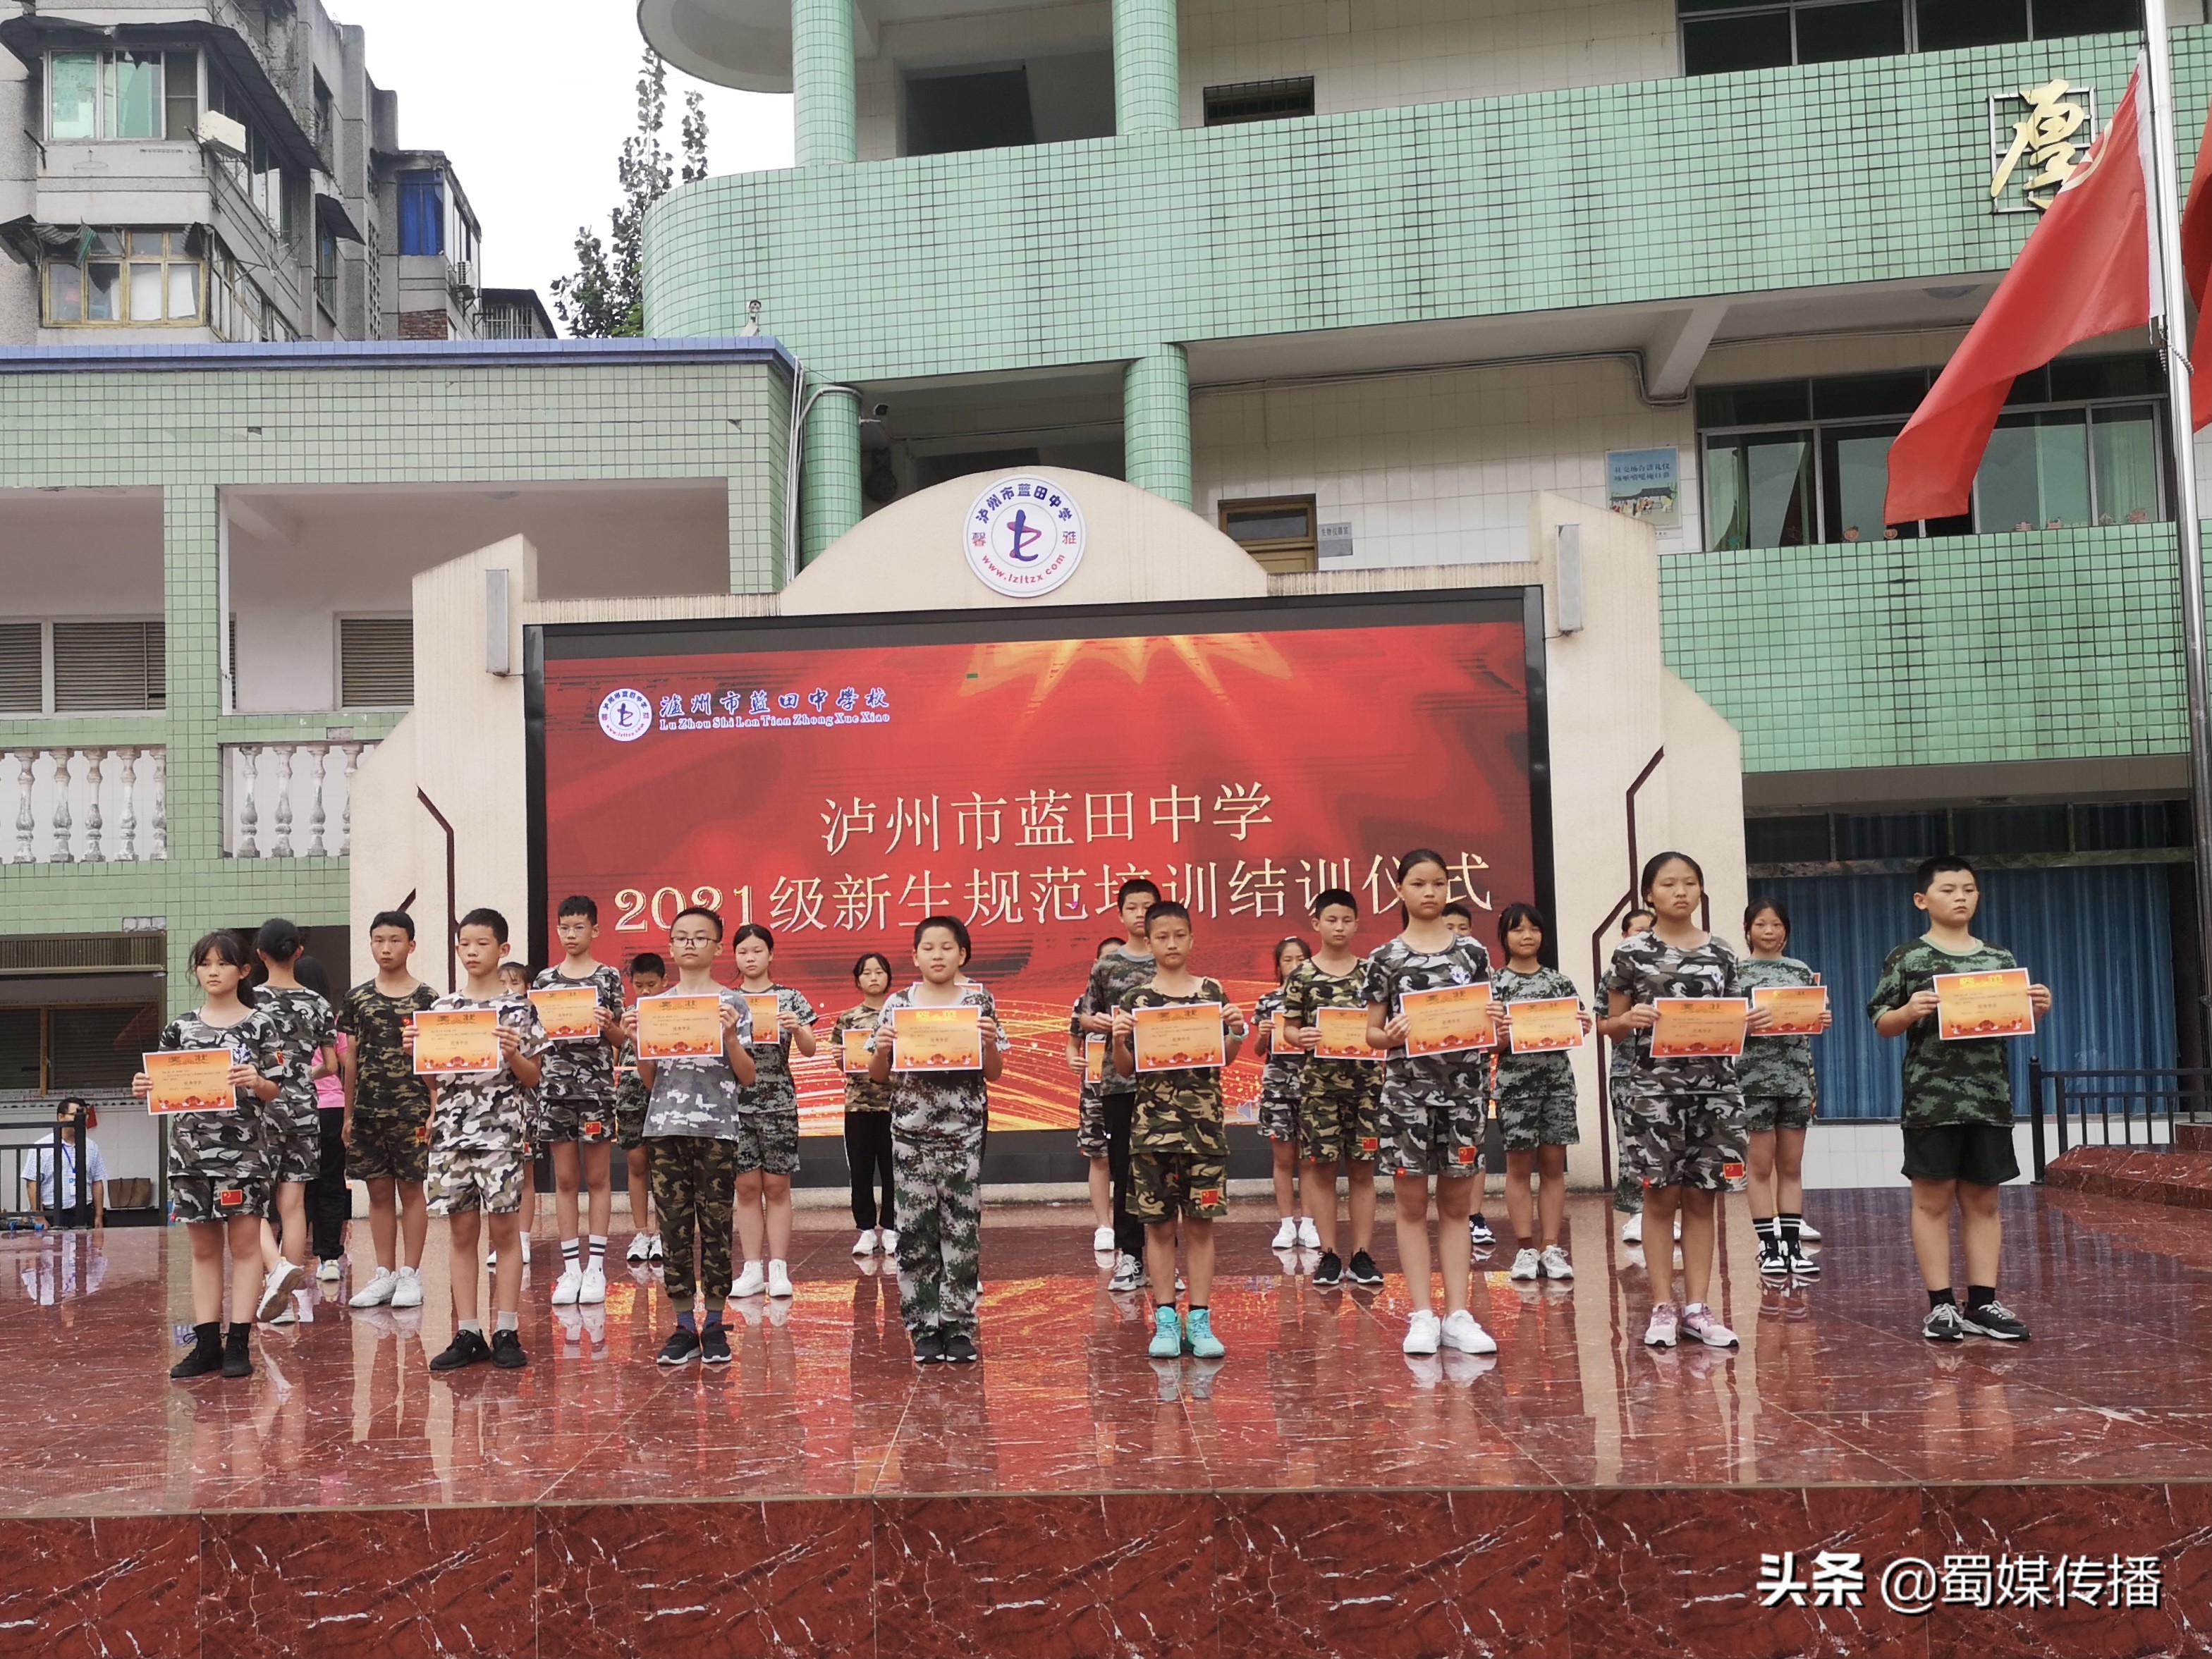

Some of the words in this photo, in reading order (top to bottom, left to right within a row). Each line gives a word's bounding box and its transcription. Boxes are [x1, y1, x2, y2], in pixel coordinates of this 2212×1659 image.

[975, 483, 1073, 524] 泸州市蓝田中学
[660, 719, 676, 730] Lu
[678, 717, 711, 730] Zhou
[713, 716, 734, 729] Shi
[736, 716, 760, 728] Lan
[761, 715, 790, 727] Tian
[793, 714, 833, 727] Zhong
[860, 711, 890, 723] Xiao
[820, 780, 1273, 856] 泸州市蓝田中学
